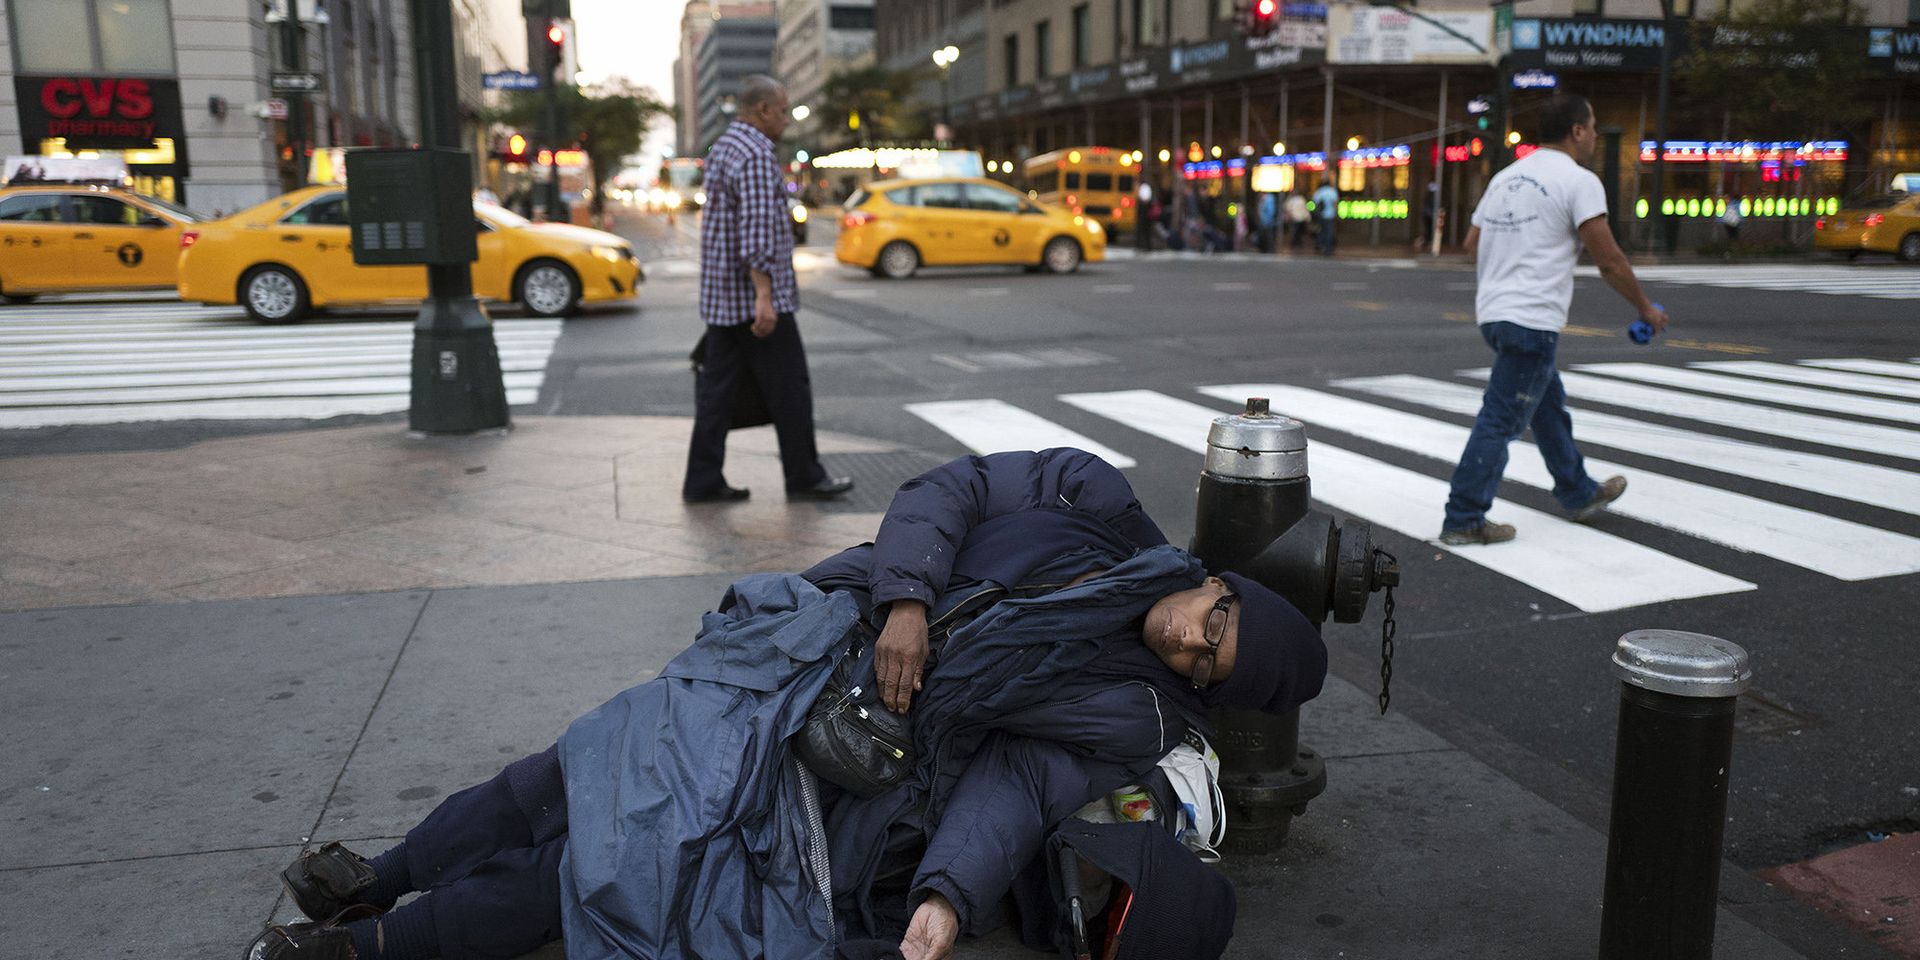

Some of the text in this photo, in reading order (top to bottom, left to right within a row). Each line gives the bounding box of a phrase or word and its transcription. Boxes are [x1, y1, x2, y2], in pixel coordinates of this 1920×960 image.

[1544, 22, 1664, 47] WYNDHAM
[1545, 50, 1579, 66] New
[41, 78, 154, 119] CVS
[47, 118, 156, 140] pharmacy
